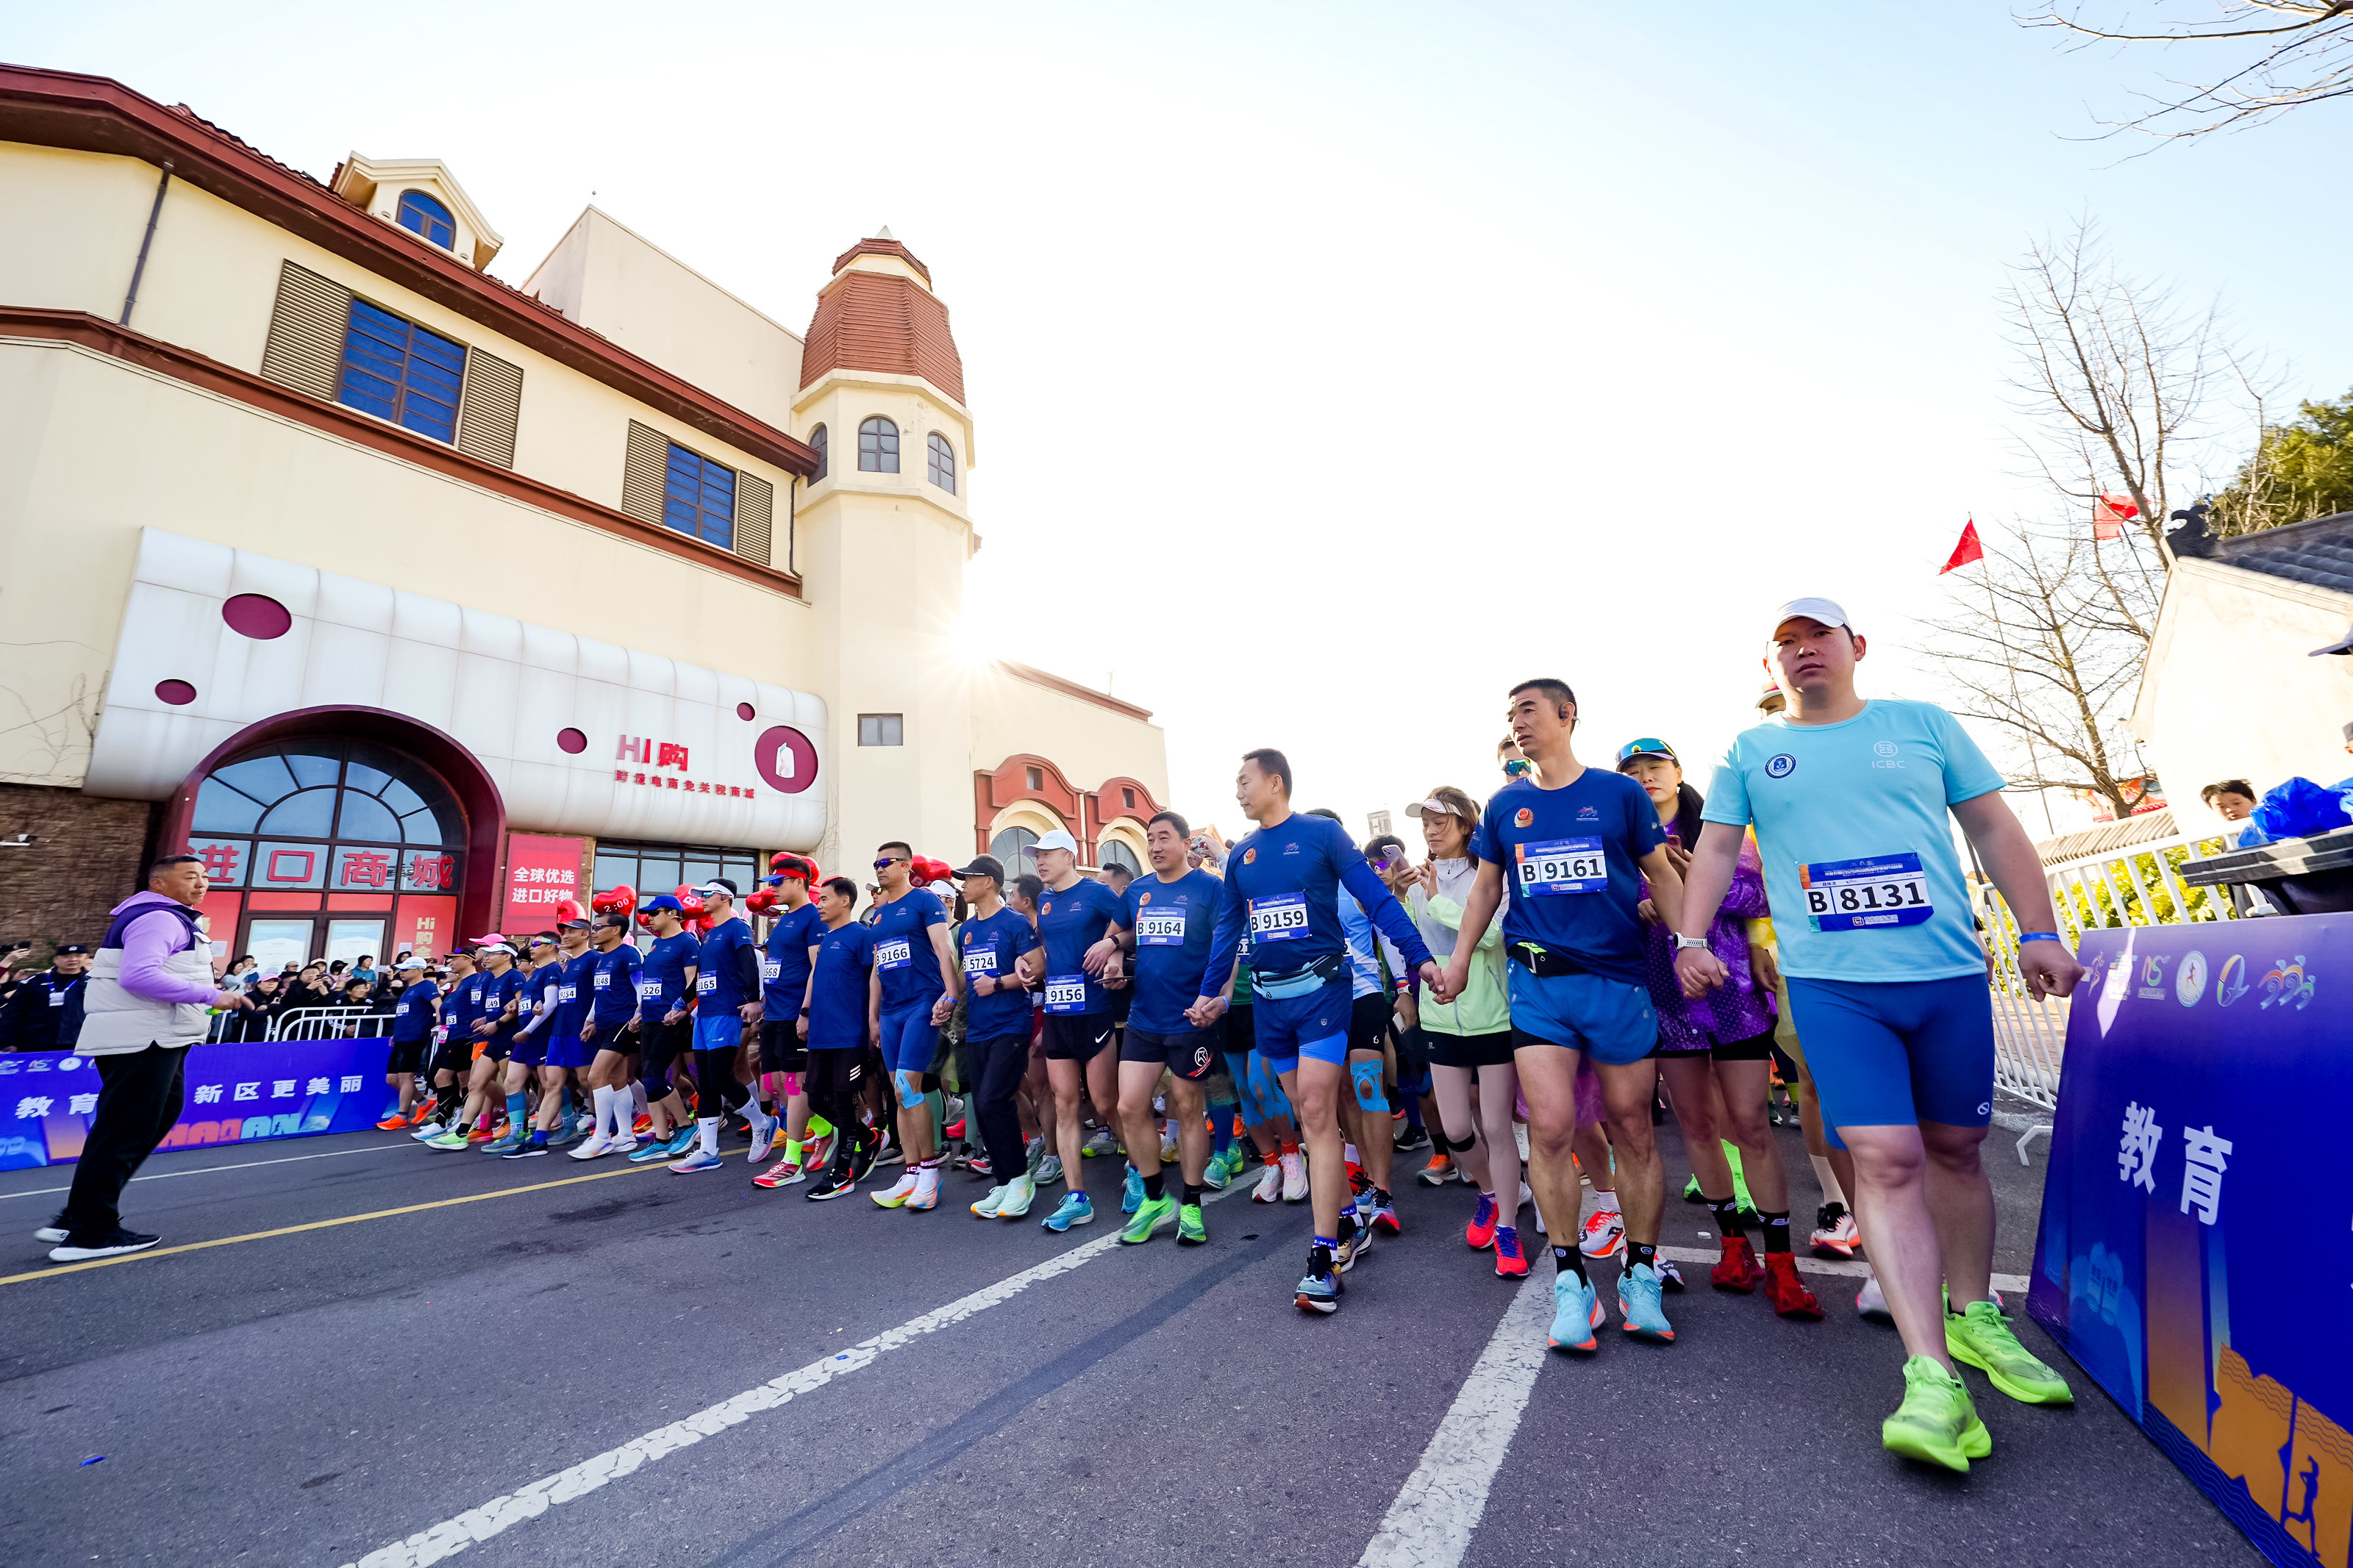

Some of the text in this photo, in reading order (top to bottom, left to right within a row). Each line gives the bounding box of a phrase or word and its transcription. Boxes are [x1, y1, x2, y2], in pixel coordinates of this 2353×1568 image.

[1871, 760, 1906, 769] ICBC
[513, 867, 575, 884] 全球优选
[1545, 858, 1602, 879] 9161
[511, 887, 574, 904] 进口好物
[1840, 881, 1925, 911] 8131
[1263, 910, 1304, 928] 9159
[1149, 922, 1182, 935] 9164
[882, 947, 907, 962] 9166
[970, 956, 994, 970] 5724
[1051, 988, 1082, 1002] 9156
[193, 1075, 363, 1104] 新区更美丽
[2118, 1100, 2233, 1225] 教育
